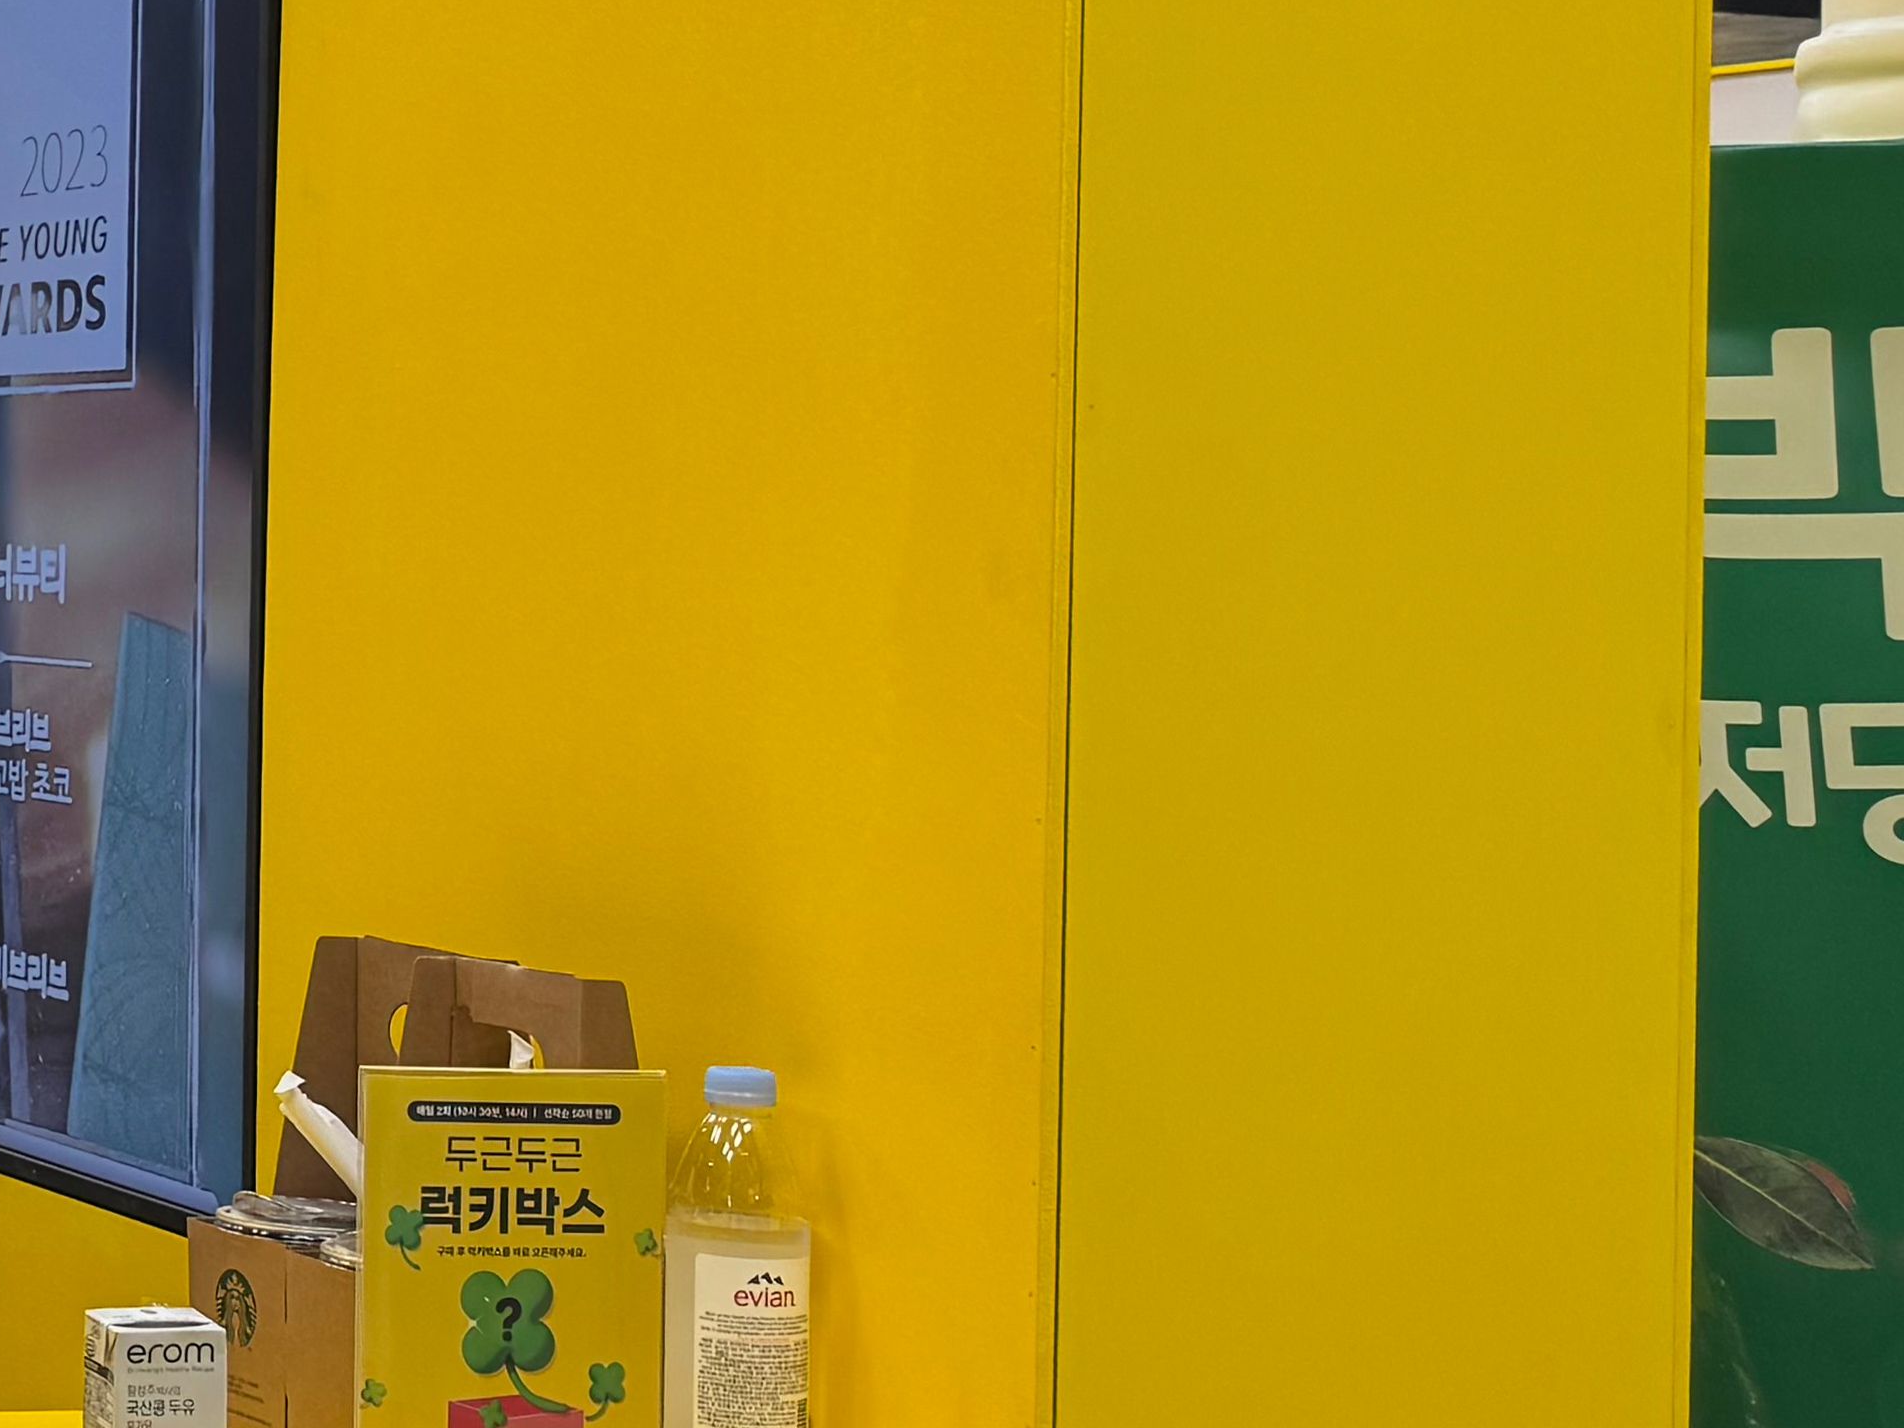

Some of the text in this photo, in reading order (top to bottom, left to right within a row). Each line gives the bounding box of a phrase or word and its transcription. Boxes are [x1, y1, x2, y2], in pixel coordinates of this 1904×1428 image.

[20, 124, 109, 197] 2023
[19, 214, 108, 263] YOUNG
[31, 762, 73, 805] 초코
[445, 1137, 582, 1173] 두근두근
[421, 1186, 605, 1235] 럭키박스
[734, 1287, 796, 1308] evian
[127, 1343, 214, 1364] erom
[127, 1399, 195, 1417] 국산콩 두유
